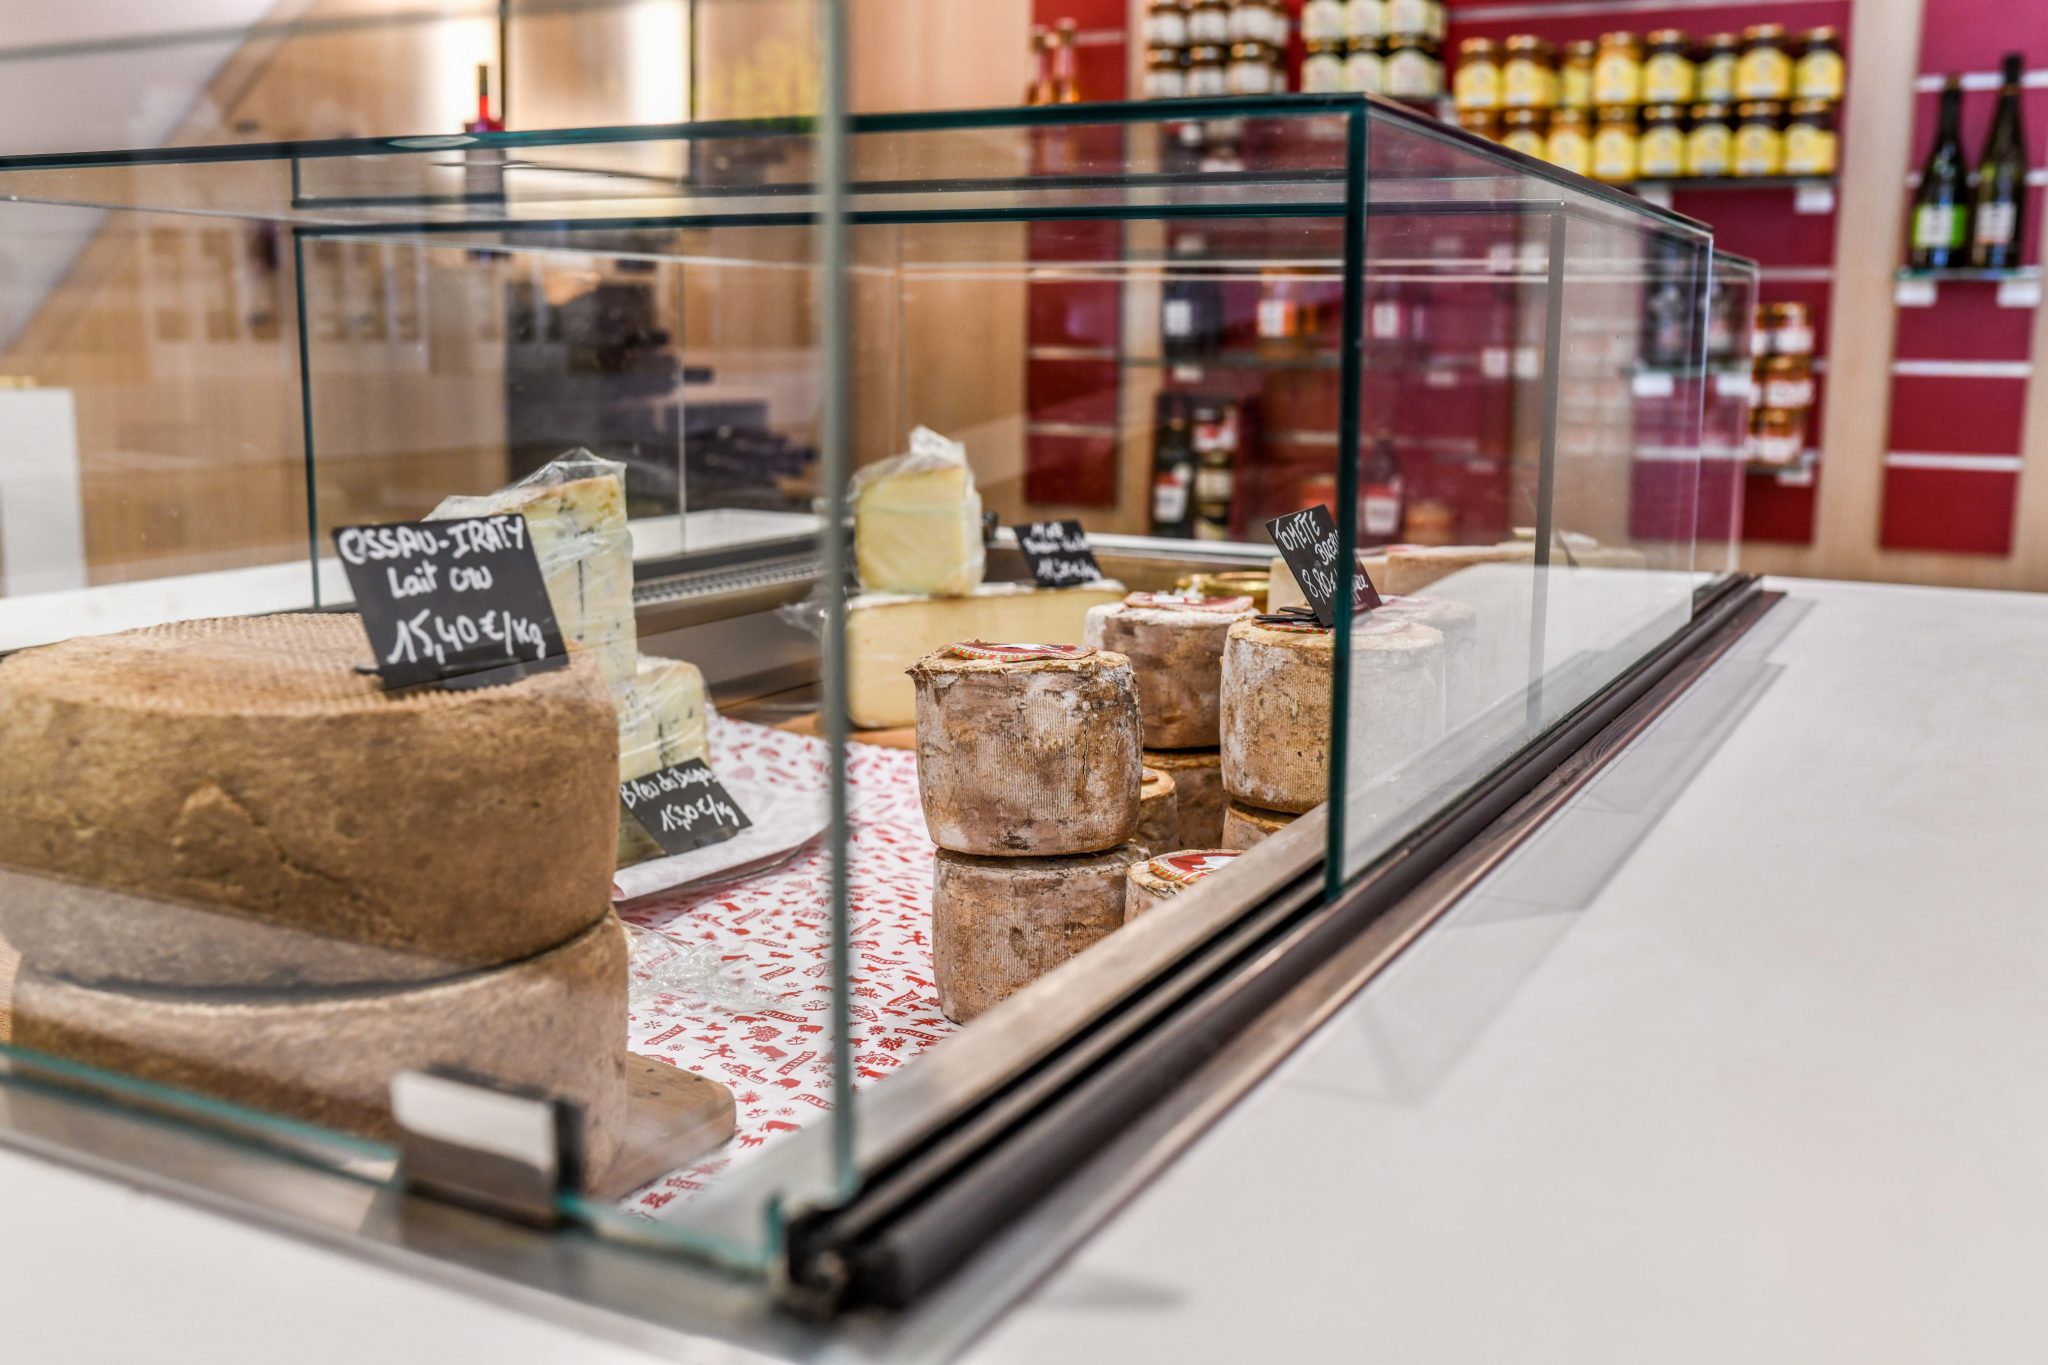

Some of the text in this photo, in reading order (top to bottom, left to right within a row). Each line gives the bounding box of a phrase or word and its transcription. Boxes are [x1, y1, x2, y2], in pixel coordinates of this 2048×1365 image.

[338, 516, 525, 564] OSSAU-IRATY
[387, 560, 438, 598] Lait
[620, 779, 660, 809] Bleu
[763, 1010, 806, 1022] ONETIK
[650, 1026, 683, 1045] ONETIK
[783, 1052, 814, 1073] ONETIK
